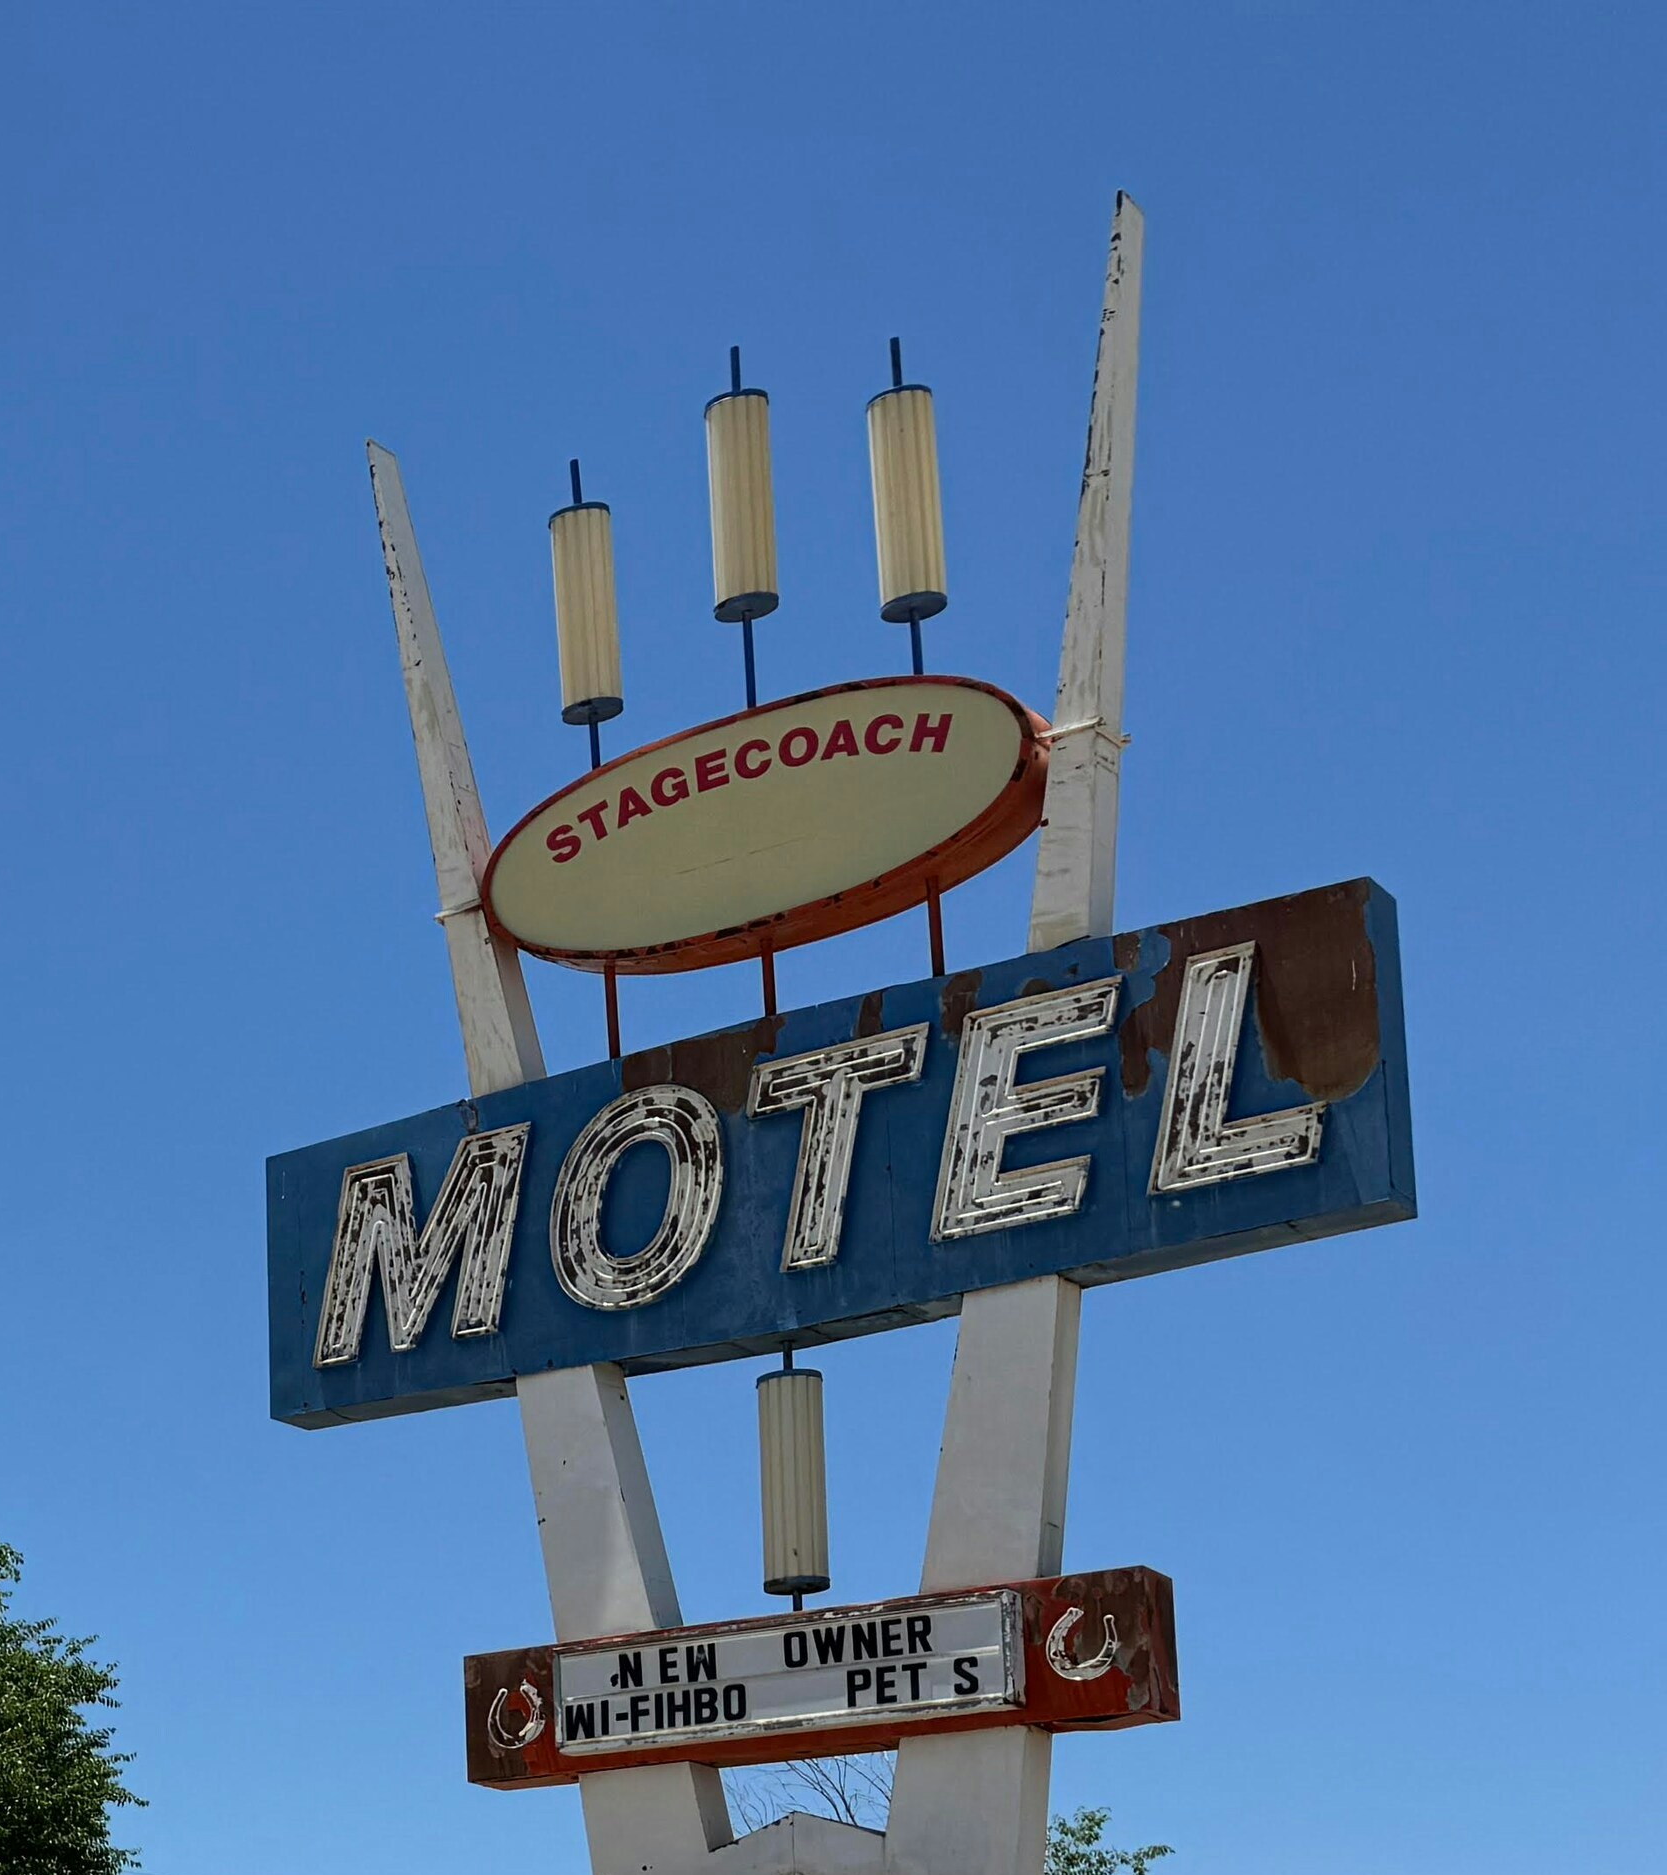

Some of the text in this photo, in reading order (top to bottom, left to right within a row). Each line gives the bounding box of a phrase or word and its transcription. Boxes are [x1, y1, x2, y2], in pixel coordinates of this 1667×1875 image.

[545, 713, 953, 863] STAGECOACH
[312, 940, 1328, 1369] MOTEL
[783, 1614, 932, 1669] OWNER
